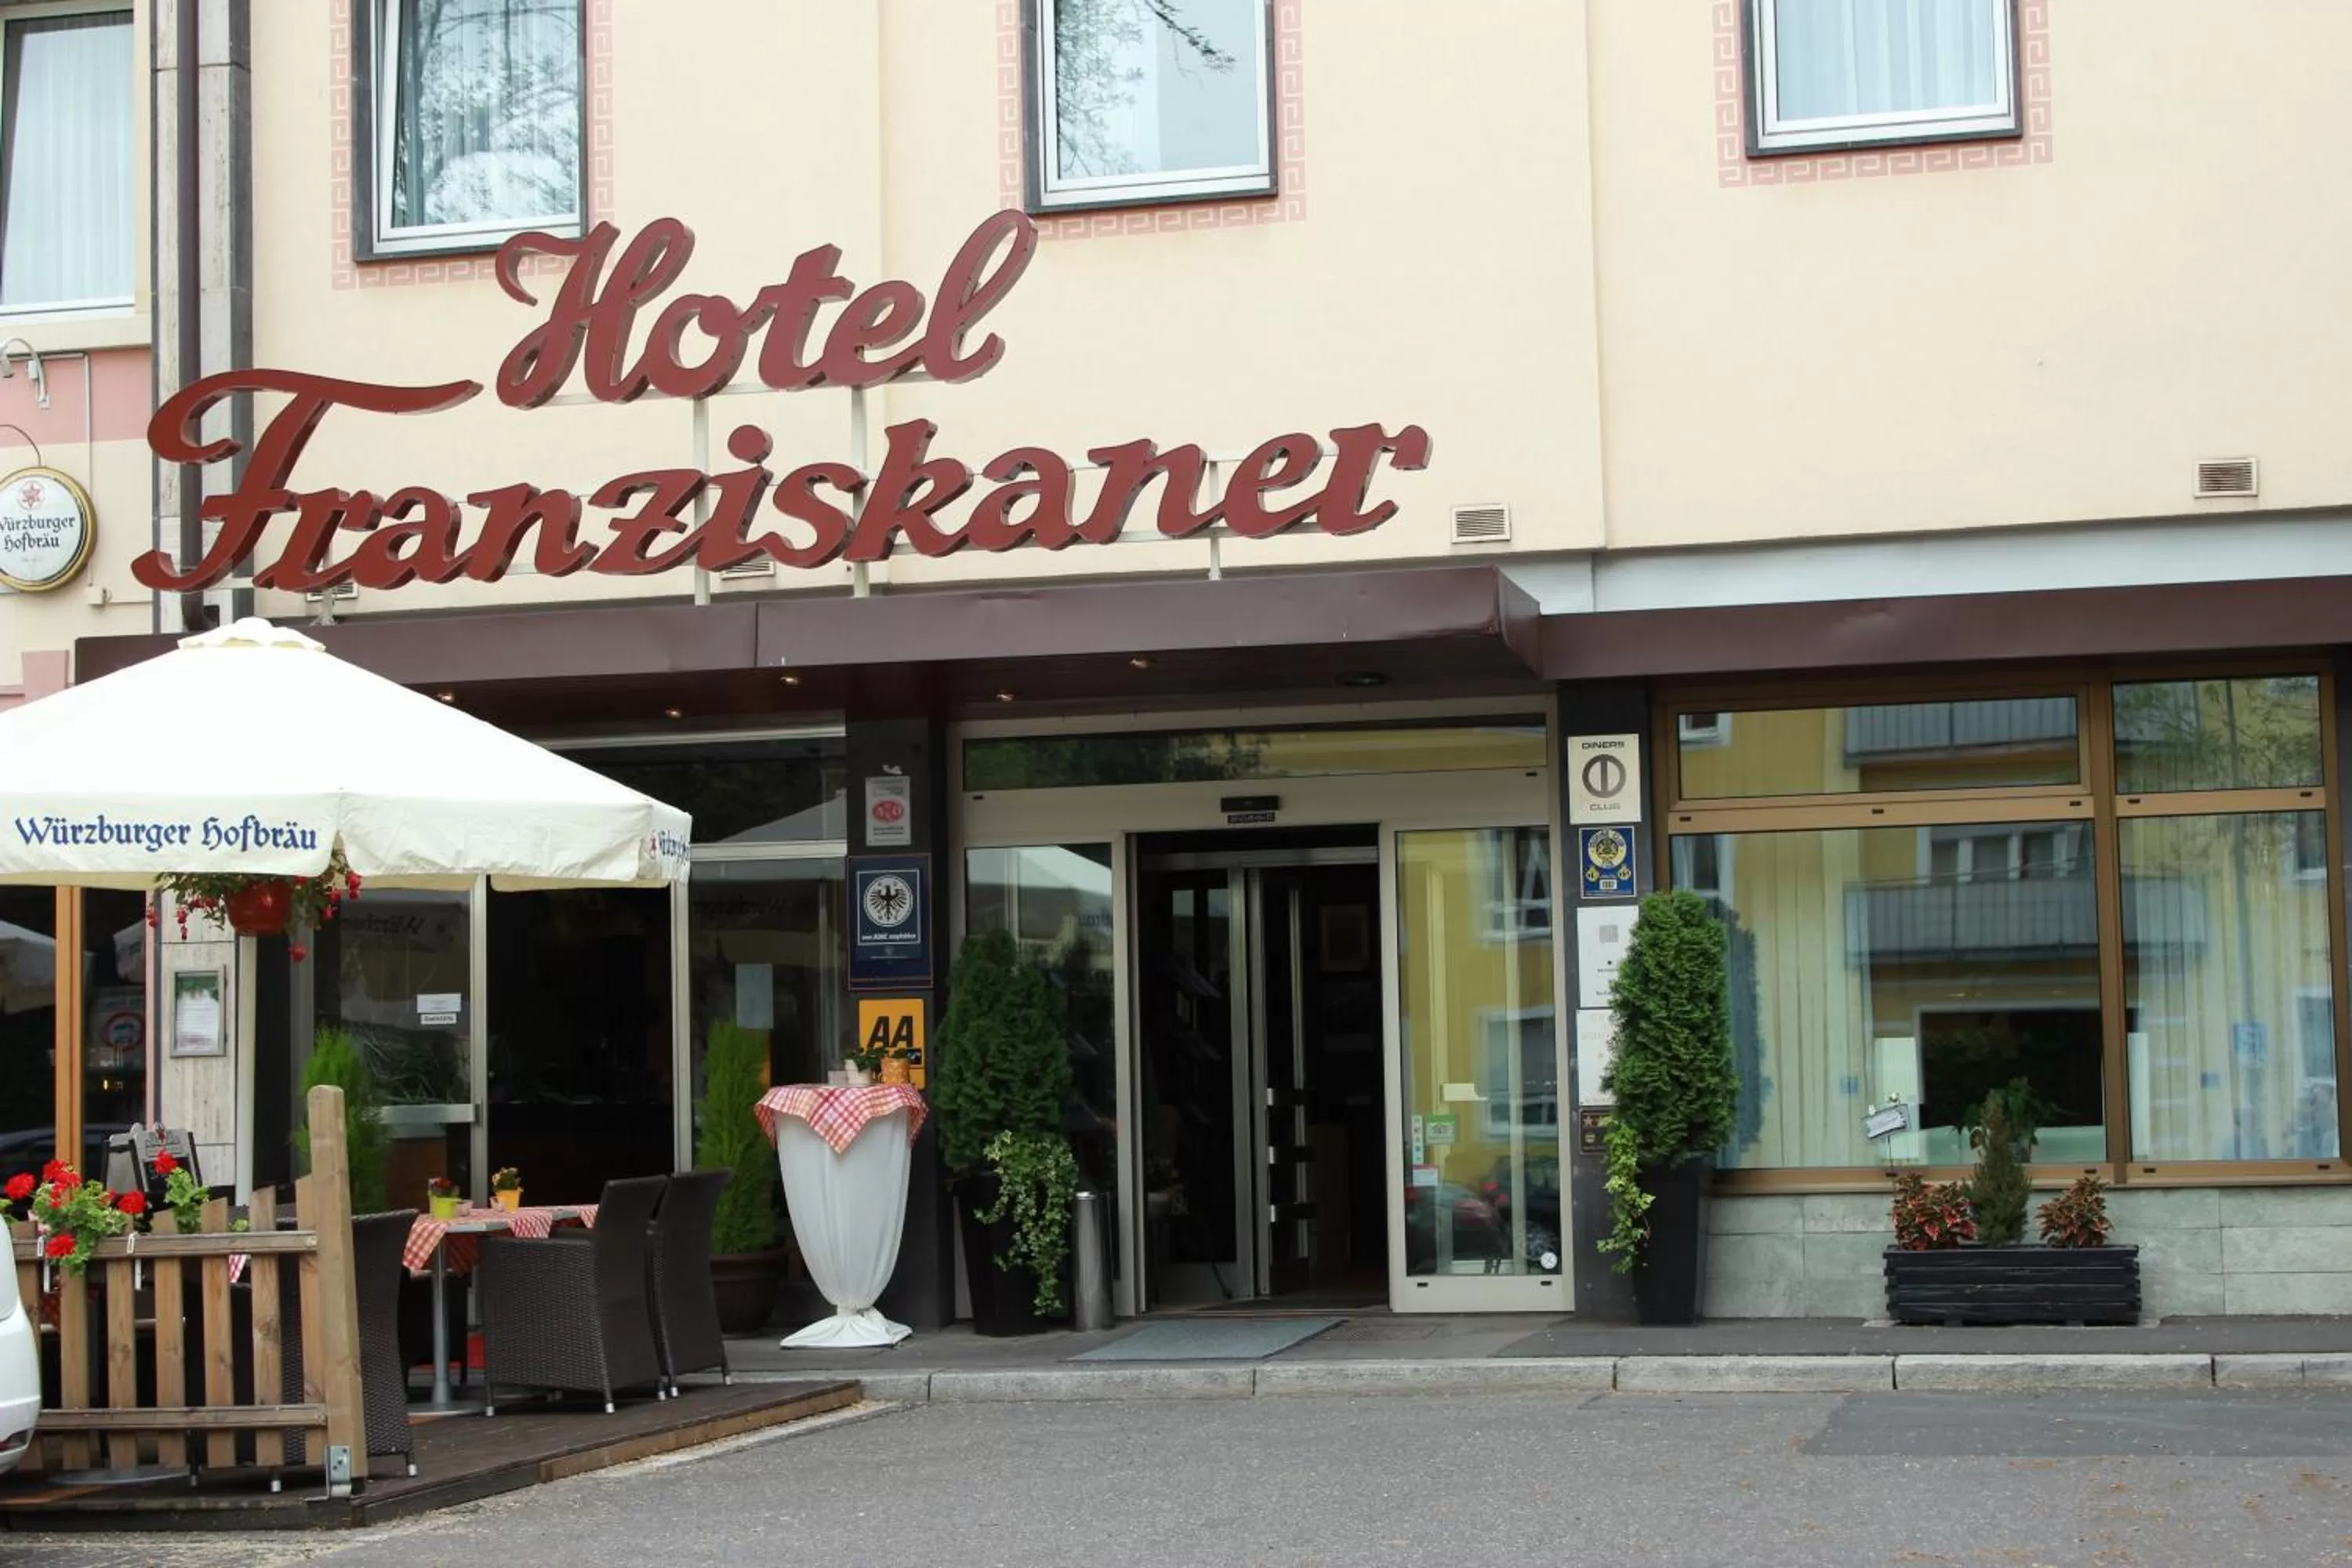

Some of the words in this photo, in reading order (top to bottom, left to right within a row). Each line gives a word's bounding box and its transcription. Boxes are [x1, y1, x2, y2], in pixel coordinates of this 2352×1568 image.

[495, 209, 1039, 410] Hotel
[131, 368, 1432, 593] Franziskaner
[4, 532, 60, 553] Hofbräu
[1581, 741, 1625, 750] DINERS
[15, 815, 191, 853] Würzburger
[201, 815, 318, 852] Hofbräu
[866, 1015, 913, 1052] AA
